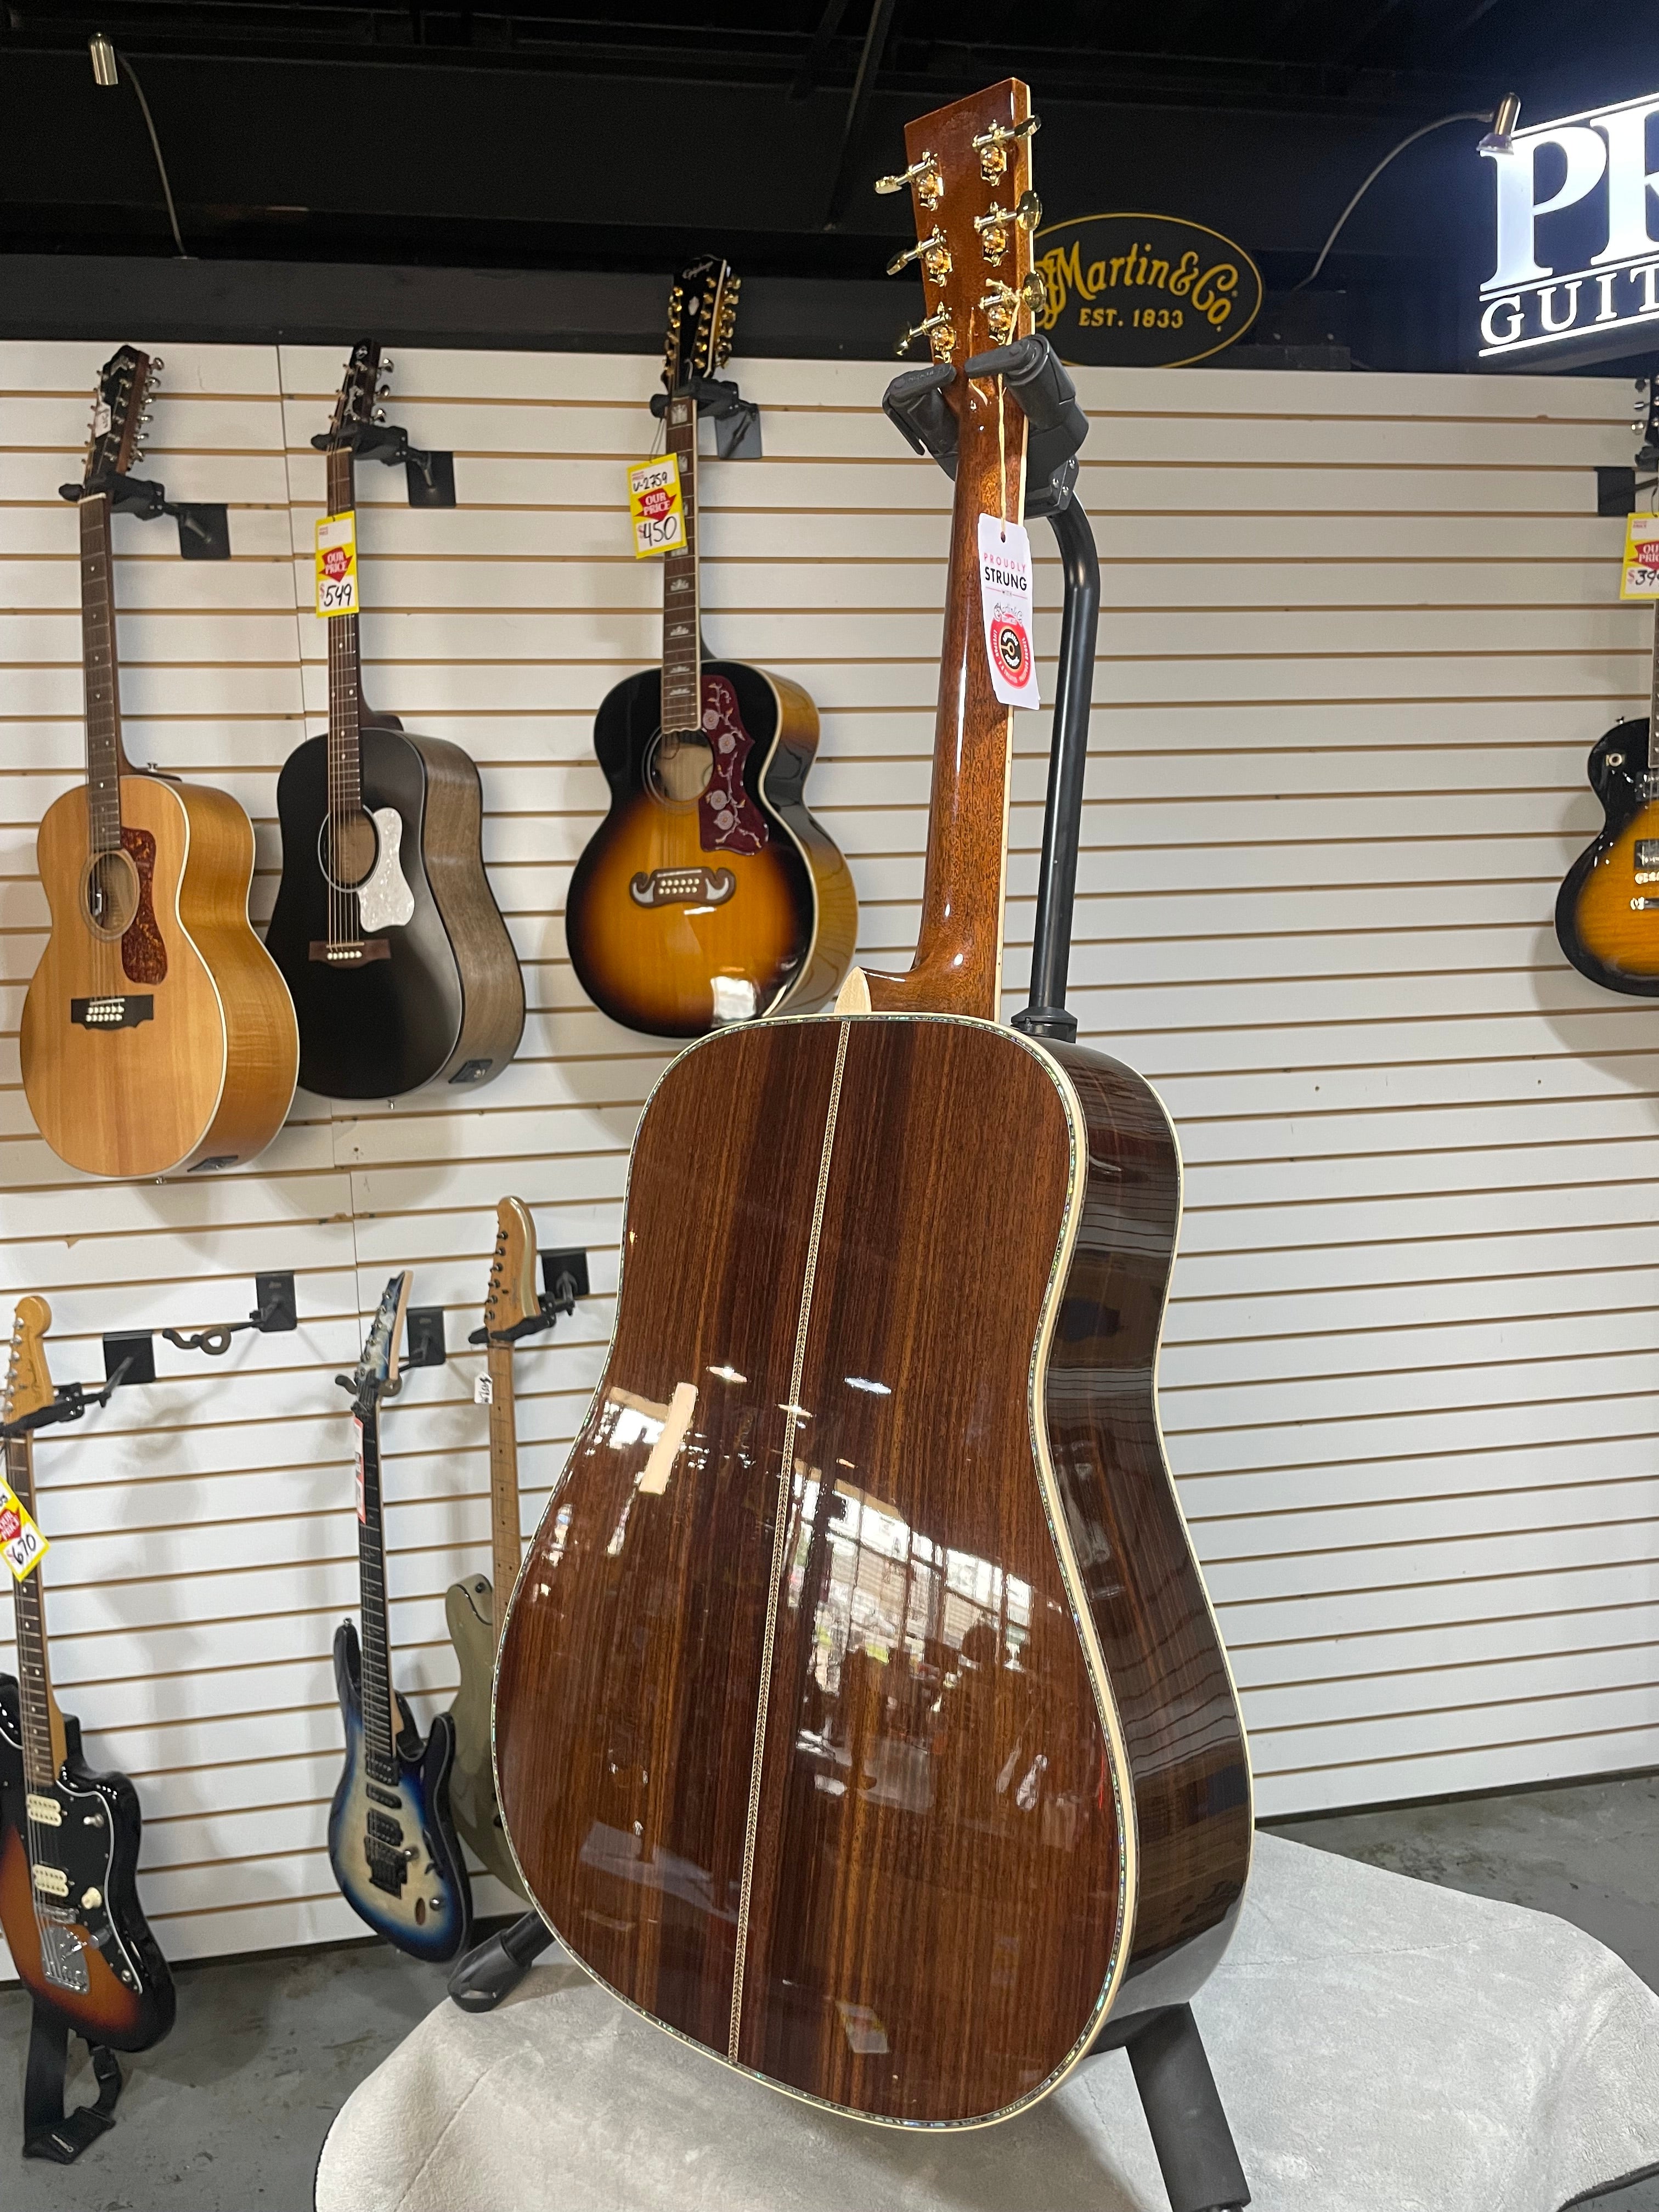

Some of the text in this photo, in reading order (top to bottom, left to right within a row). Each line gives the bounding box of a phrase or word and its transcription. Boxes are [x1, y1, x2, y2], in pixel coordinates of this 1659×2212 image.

[1079, 307, 1184, 329] EST. 1833
[644, 500, 671, 516] PRICE
[645, 492, 667, 505] OUR
[984, 552, 1026, 573] PROUDLY
[985, 566, 1027, 591] STRUNG
